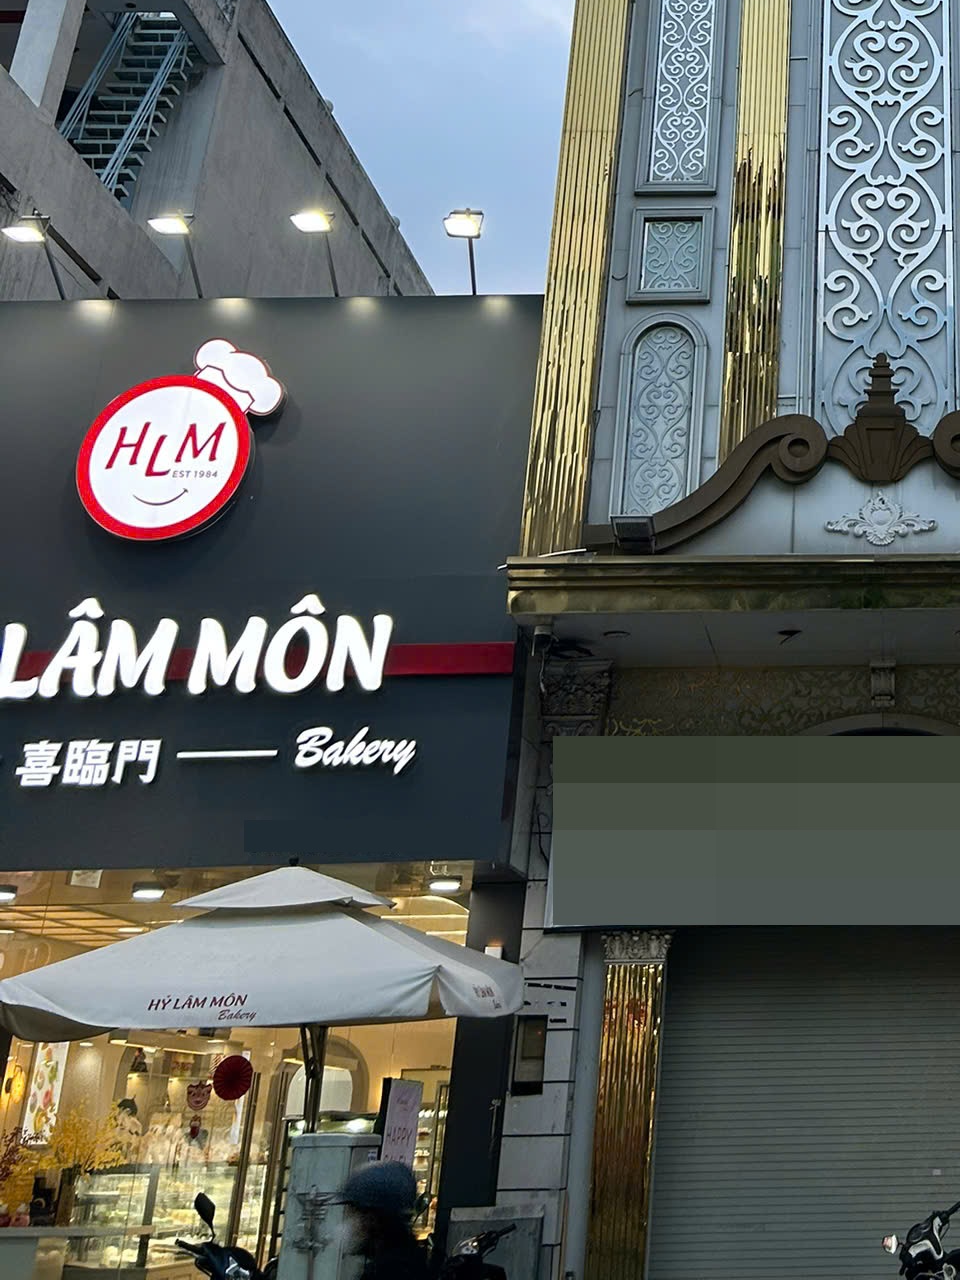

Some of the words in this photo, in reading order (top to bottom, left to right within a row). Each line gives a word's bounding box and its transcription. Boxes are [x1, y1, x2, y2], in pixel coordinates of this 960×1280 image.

[105, 422, 226, 477] HLM
[172, 470, 191, 479] EST
[194, 470, 218, 478] 1984
[0, 597, 179, 699] LÂM
[187, 594, 393, 694] MÔN
[15, 739, 162, 786] 喜臨門
[295, 726, 416, 775] Bakery
[173, 995, 207, 1010] LÂM
[209, 993, 248, 1008] MÔN
[217, 1009, 257, 1022] Bakery
